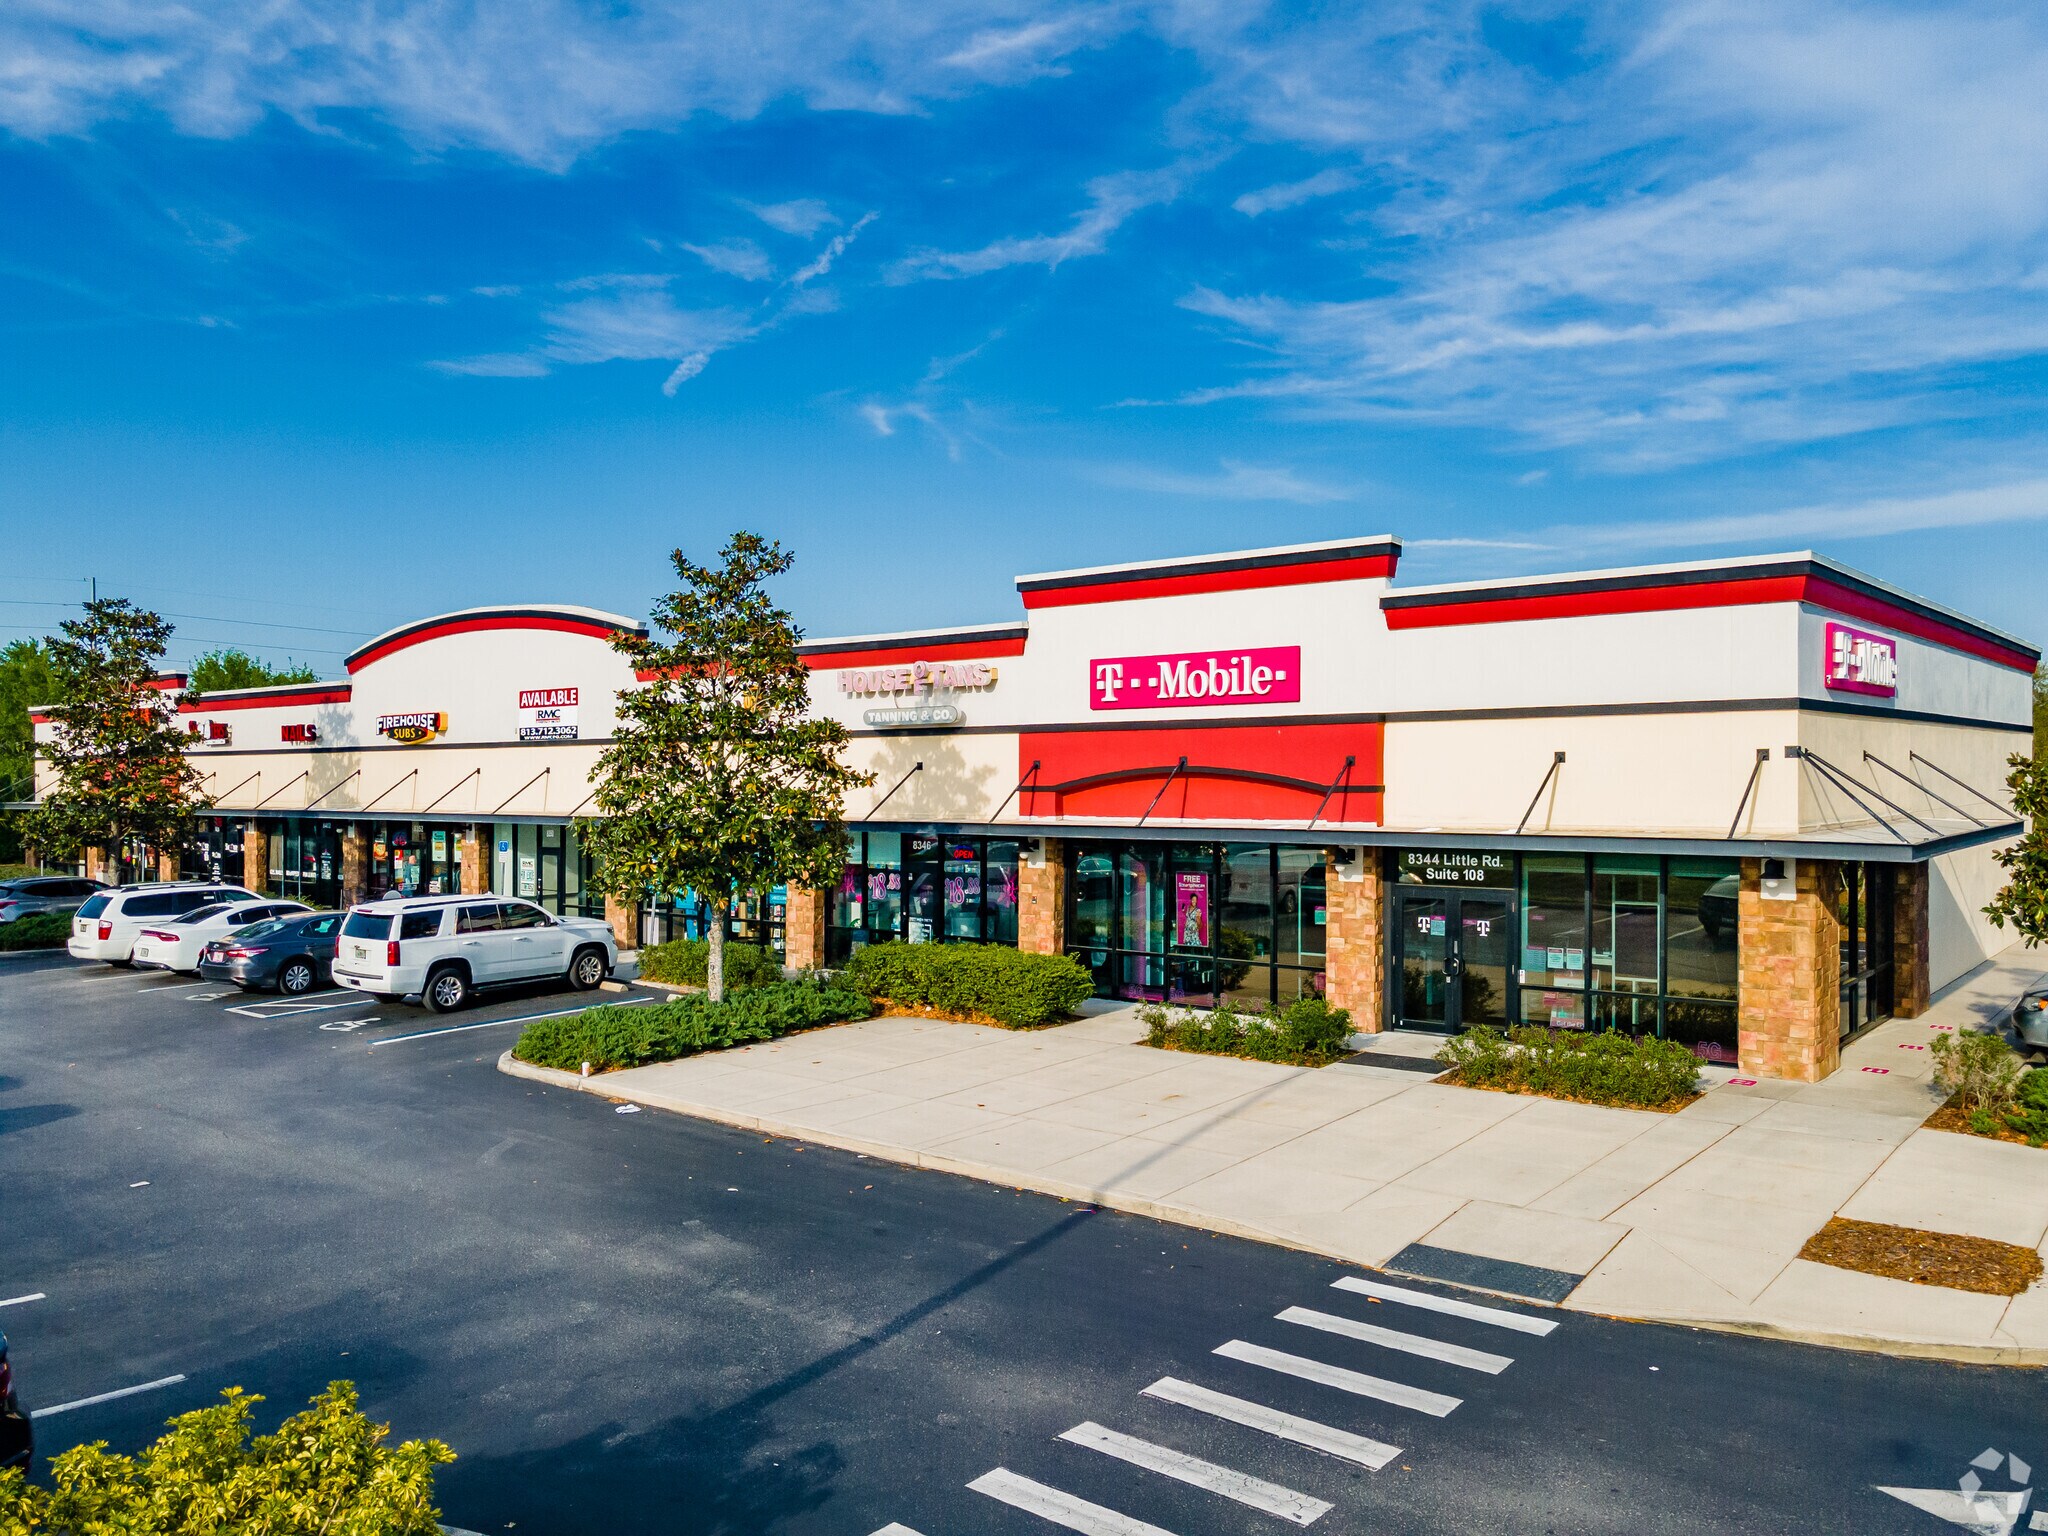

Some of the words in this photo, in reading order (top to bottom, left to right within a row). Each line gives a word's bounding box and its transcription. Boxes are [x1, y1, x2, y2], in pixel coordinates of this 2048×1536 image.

[837, 669, 911, 693] HOUSE
[913, 660, 929, 696] OF
[929, 664, 992, 688] TANS
[520, 689, 577, 707] AVAILABLE
[537, 709, 560, 718] RMC
[868, 710, 918, 723] TANNING
[921, 710, 931, 721] &
[933, 709, 953, 721] CO.
[376, 714, 435, 736] FIREHOUSE
[520, 726, 577, 736] 813.712.3062
[281, 724, 317, 742] NAILS
[393, 728, 416, 739] SUBS
[912, 840, 932, 850] 8346
[953, 849, 974, 859] OPEN
[1408, 853, 1440, 865] 8344
[1443, 854, 1478, 867] Little
[1482, 855, 1504, 867] Rd.
[1184, 875, 1201, 883] FREE
[1426, 868, 1459, 880] Suite
[1462, 869, 1485, 881] 108
[1697, 1041, 1722, 1060] 5G
